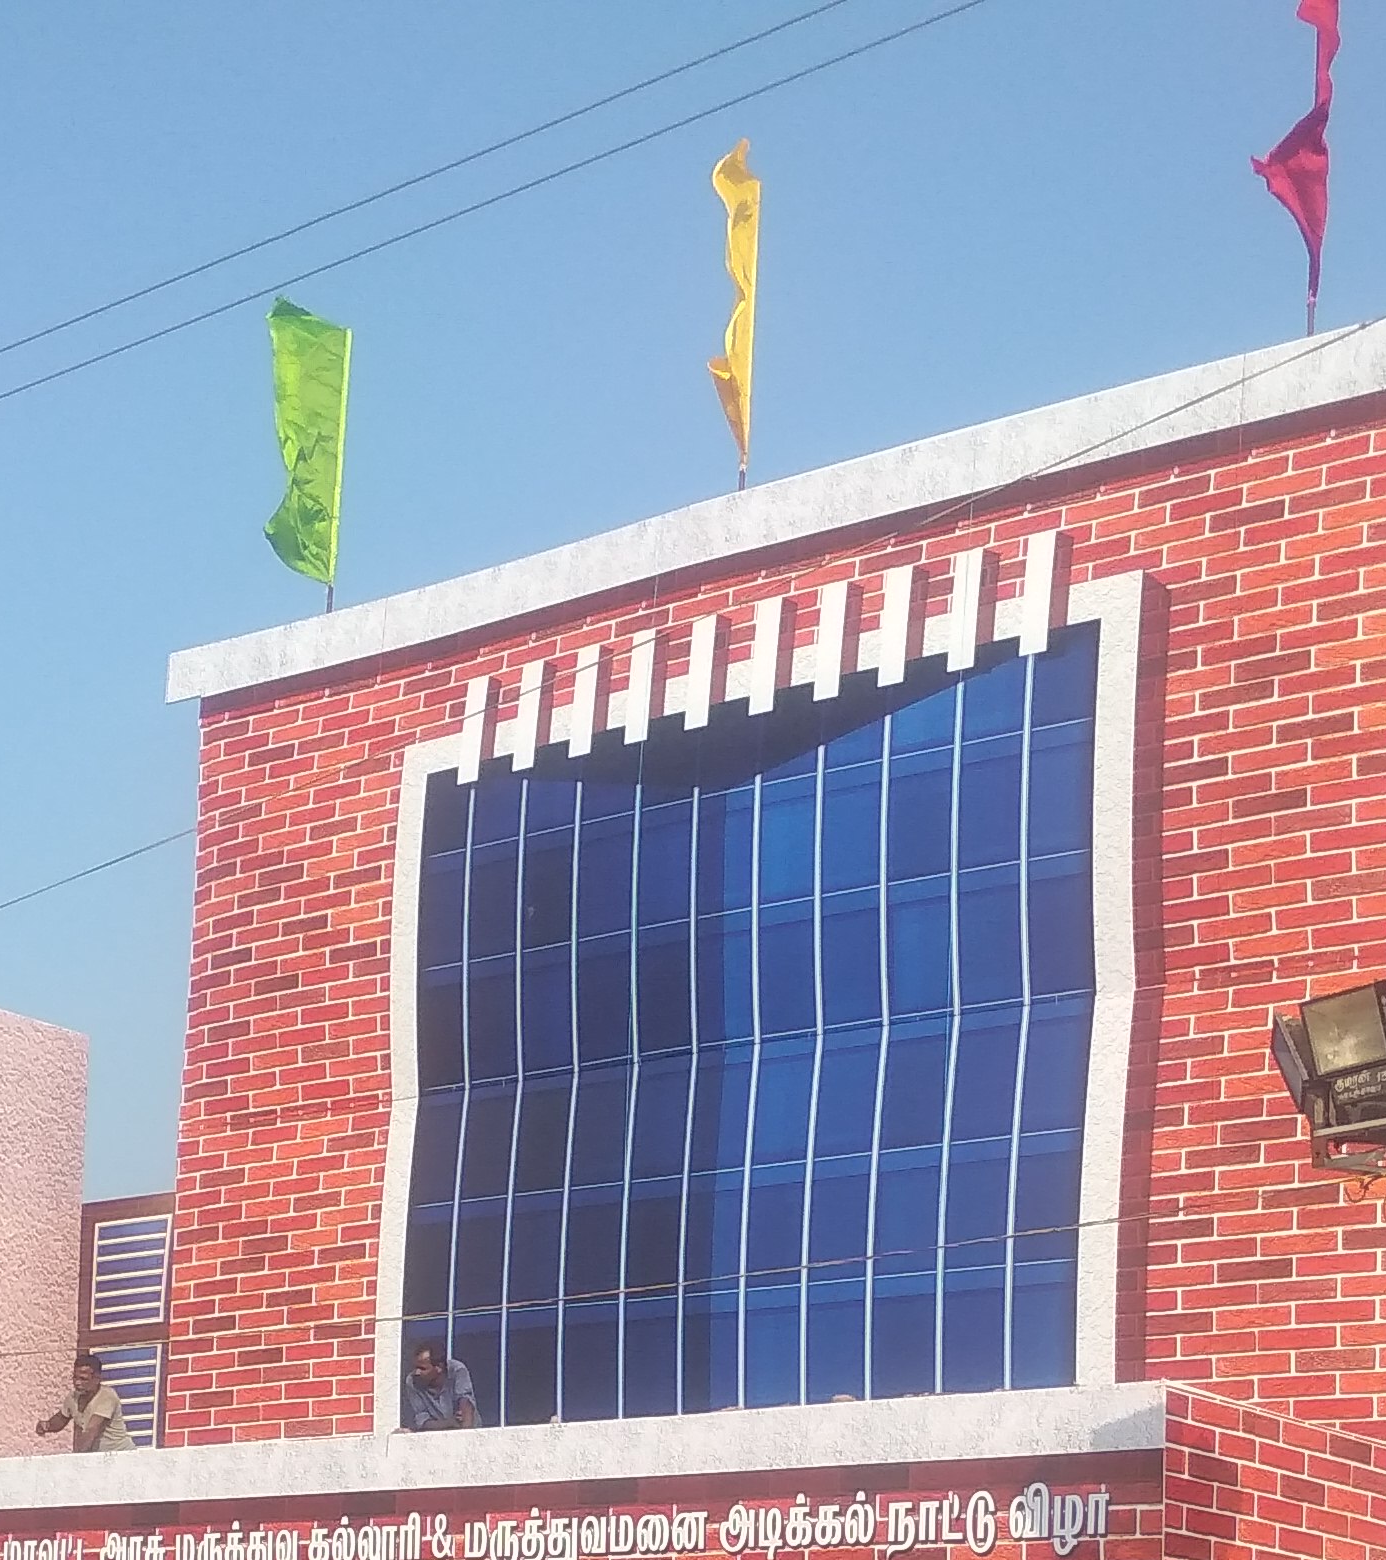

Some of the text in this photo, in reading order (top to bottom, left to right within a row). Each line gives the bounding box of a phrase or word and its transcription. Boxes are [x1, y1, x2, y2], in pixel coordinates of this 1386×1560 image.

[431, 1513, 455, 1558] &
[719, 1491, 875, 1560] அடிக்கல்
[1008, 1482, 1110, 1556] விழா
